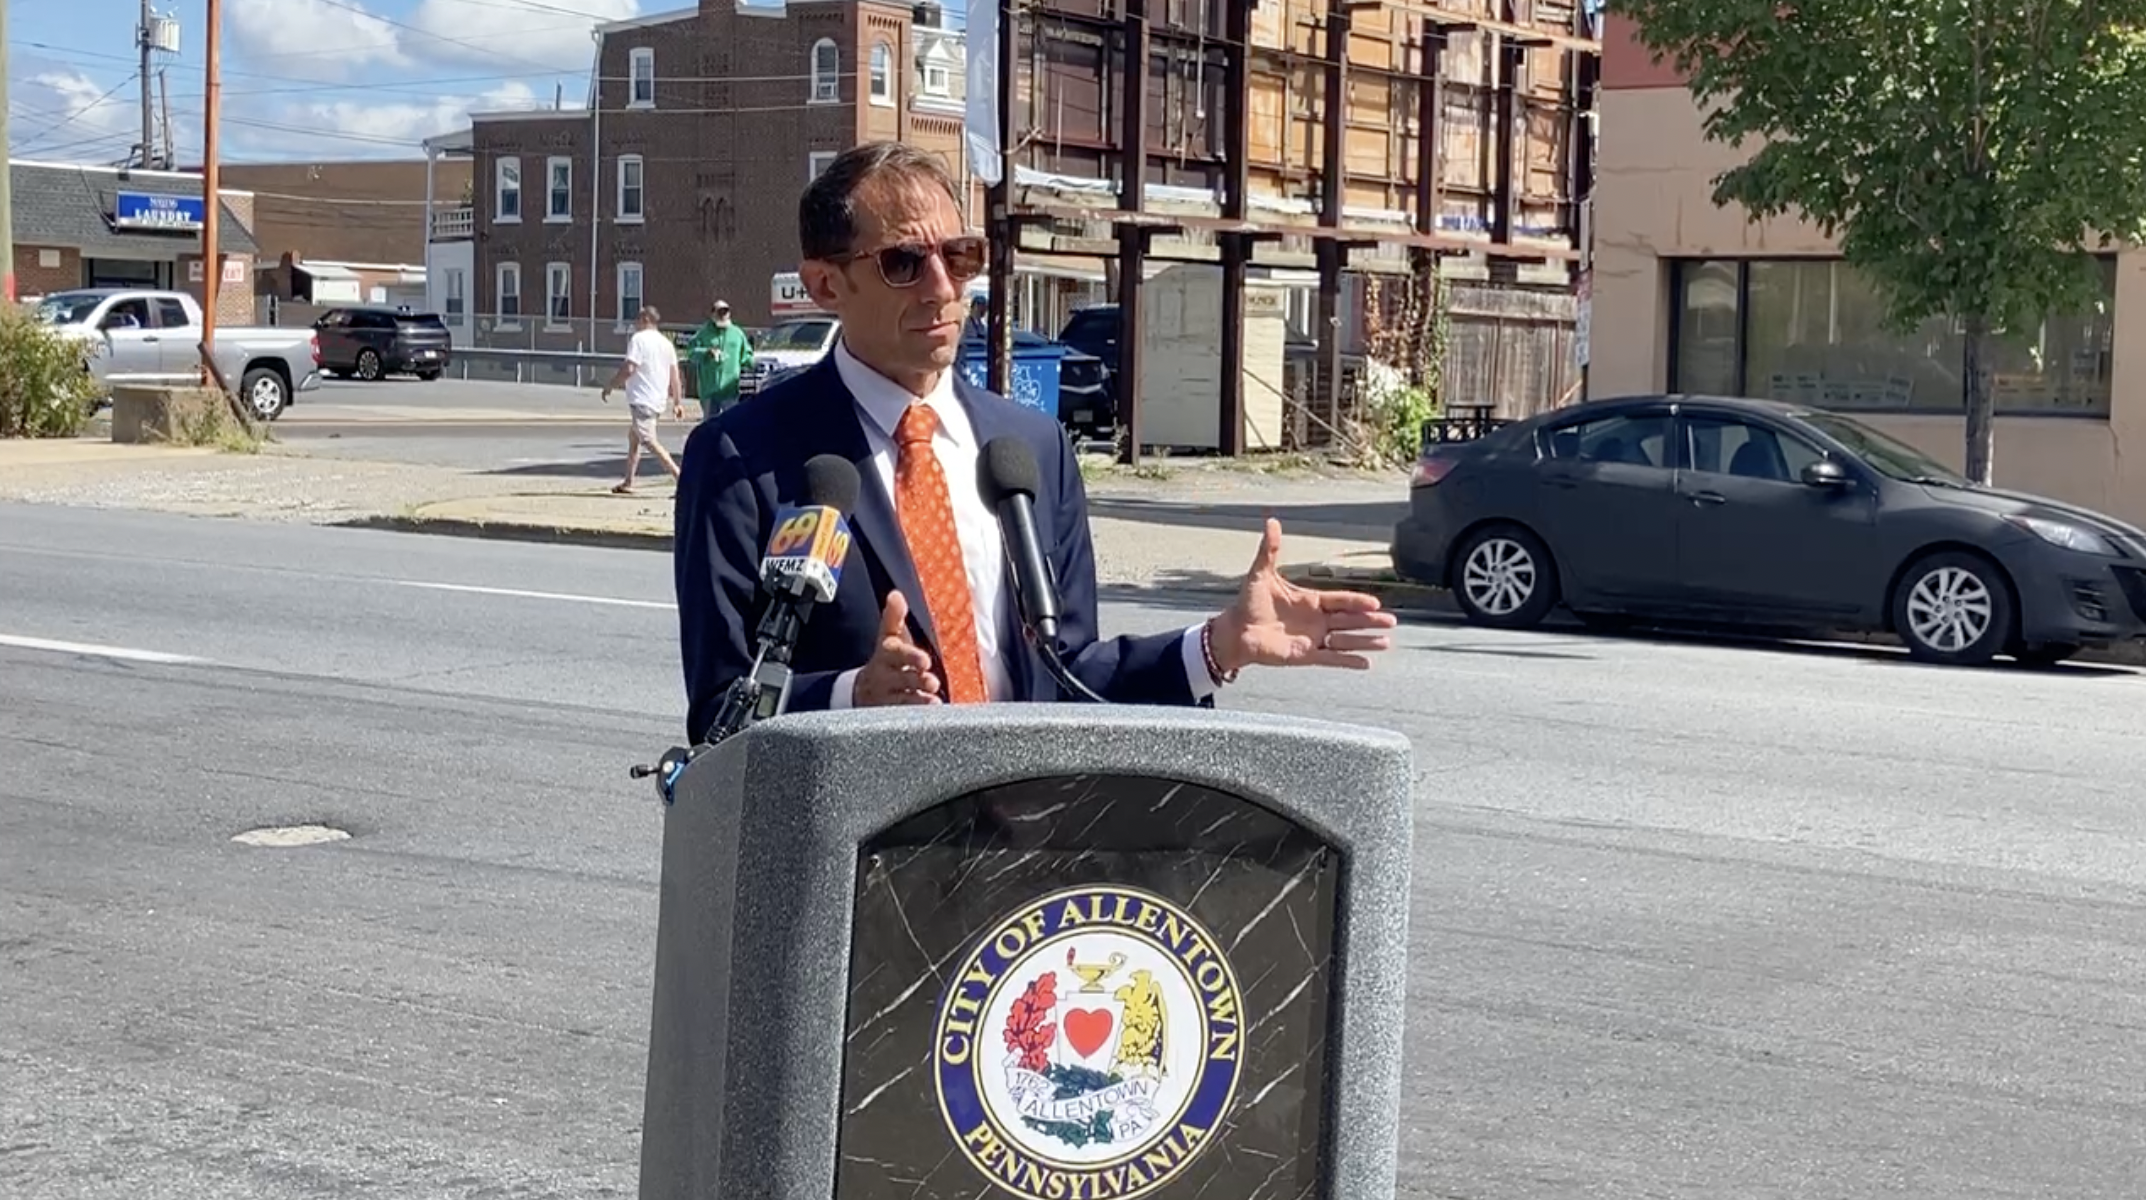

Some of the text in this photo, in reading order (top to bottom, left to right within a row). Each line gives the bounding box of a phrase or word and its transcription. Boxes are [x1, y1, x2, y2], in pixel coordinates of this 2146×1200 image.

[135, 208, 192, 222] LAUNDRY
[771, 511, 818, 555] 69
[943, 894, 1239, 1065] CITY OF ALLENTOWN
[1015, 1071, 1049, 1092] 1762
[1024, 1080, 1148, 1119] ALLENTOWN
[1119, 1119, 1142, 1138] PA
[964, 1119, 1206, 1200] PENNSYLVANIA
